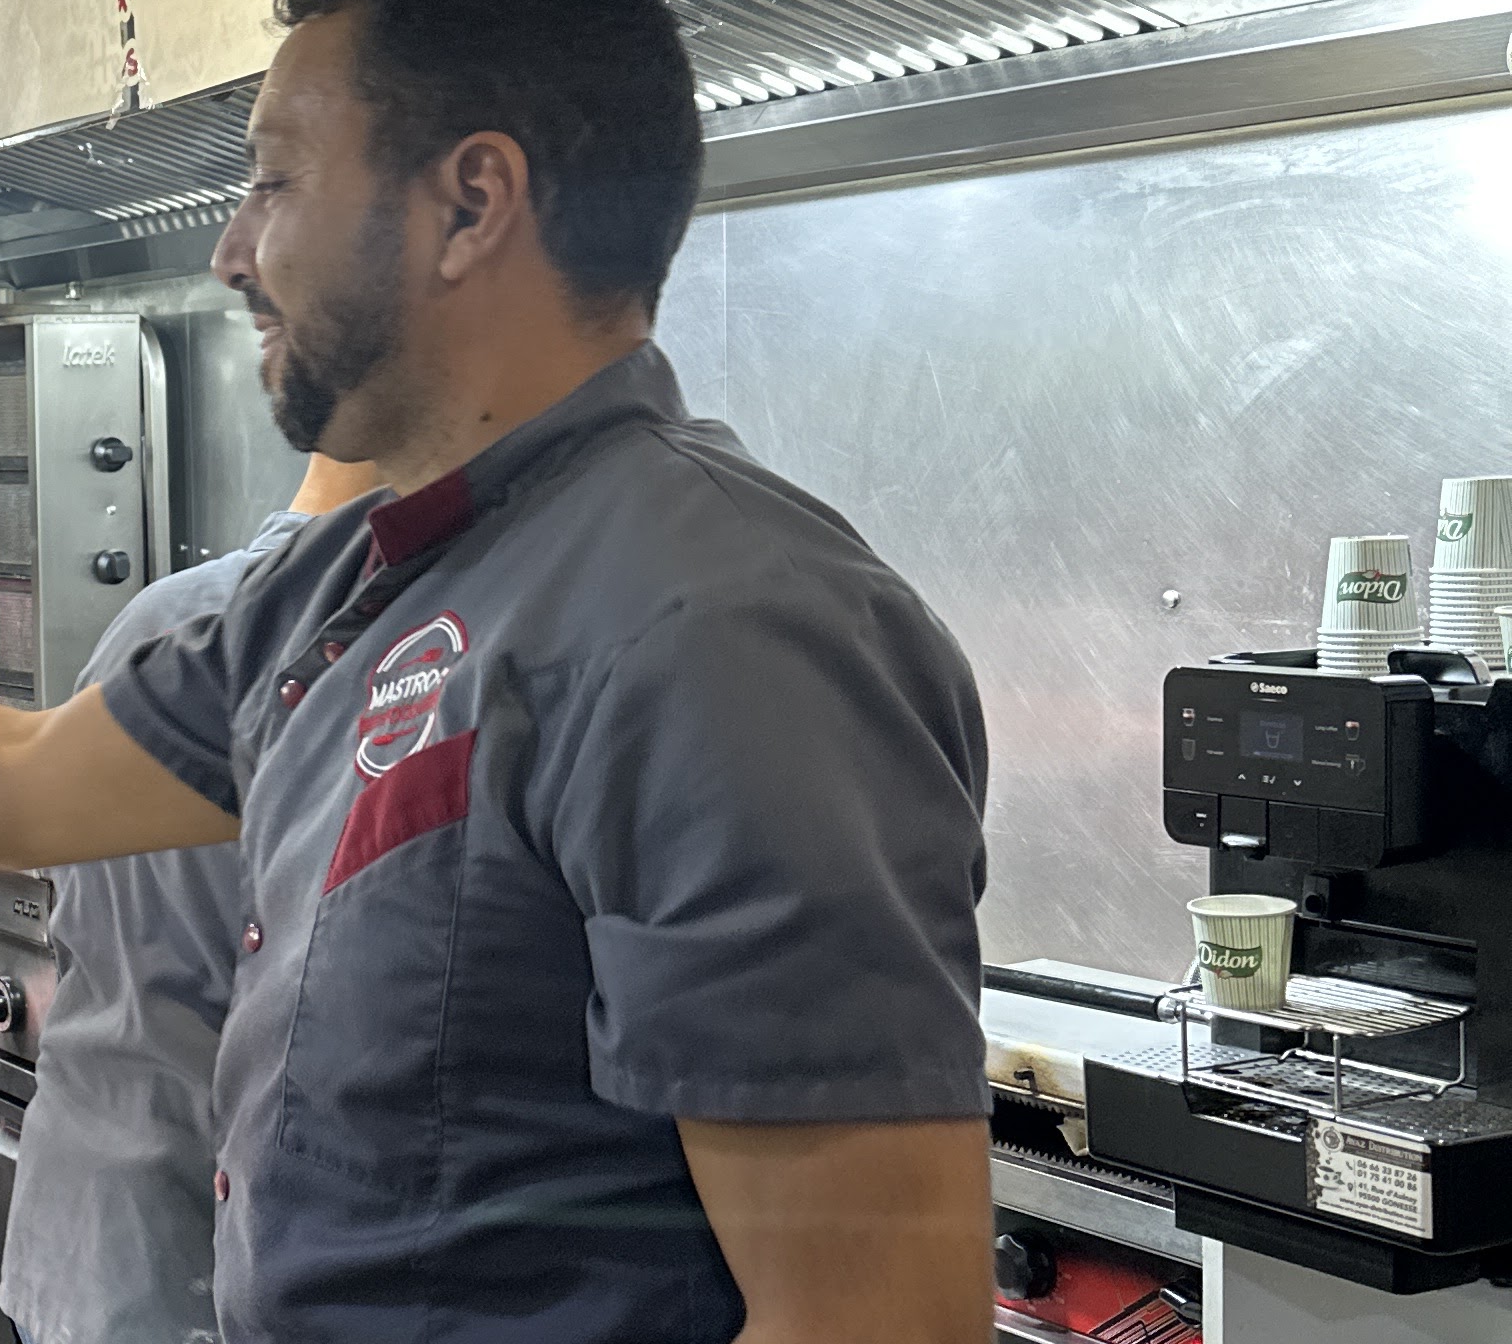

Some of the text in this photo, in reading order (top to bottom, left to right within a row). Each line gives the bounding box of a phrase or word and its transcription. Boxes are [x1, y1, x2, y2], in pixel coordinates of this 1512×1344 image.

[1340, 580, 1403, 601] Didon
[1259, 682, 1288, 695] Saeco
[1198, 942, 1259, 968] Didon
